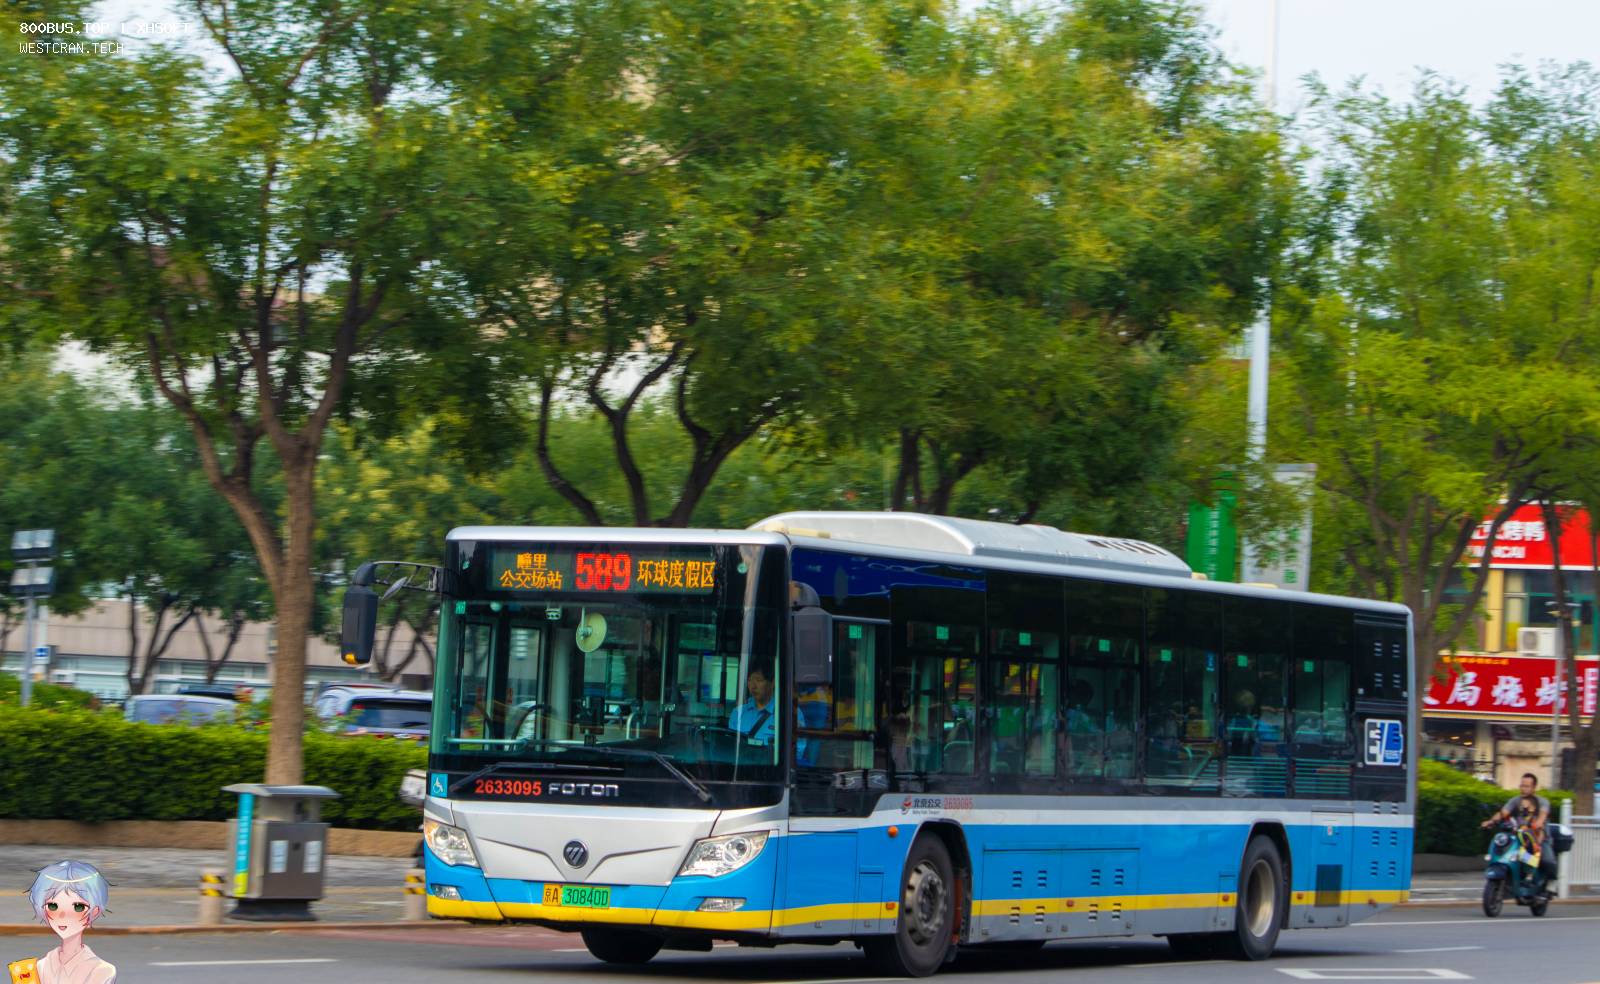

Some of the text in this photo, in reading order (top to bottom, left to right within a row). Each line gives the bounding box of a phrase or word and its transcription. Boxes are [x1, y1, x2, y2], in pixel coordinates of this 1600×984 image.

[500, 569, 563, 590] 公交场站
[575, 552, 632, 591] 589
[637, 559, 716, 589] 环球度假区
[474, 779, 542, 796] 2633095
[548, 783, 620, 797] FOTON
